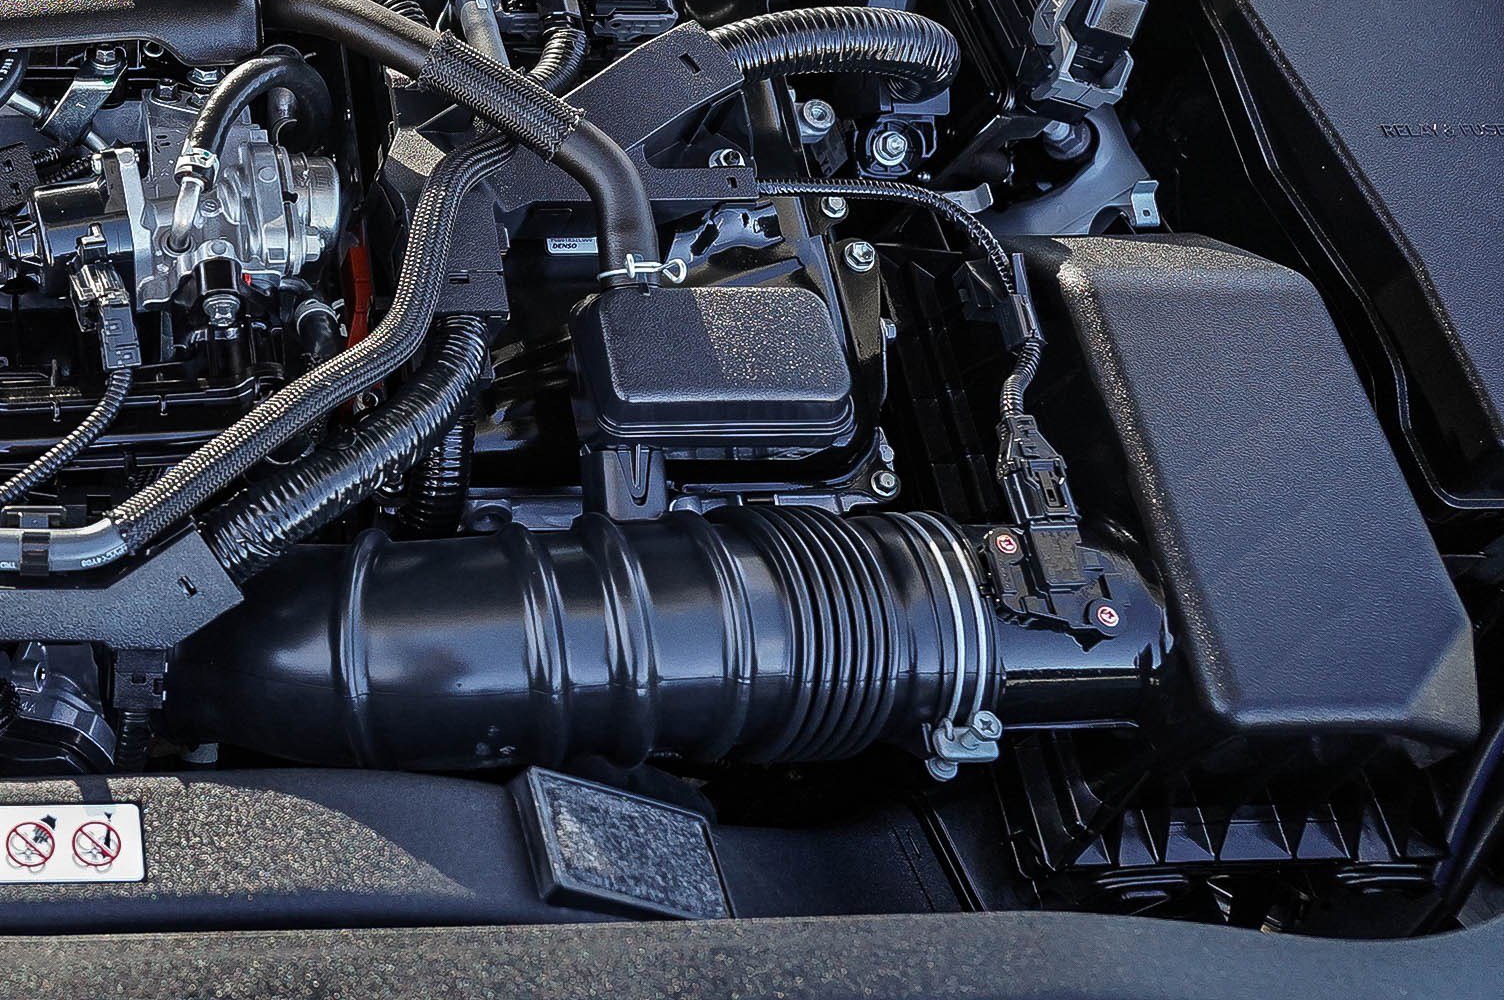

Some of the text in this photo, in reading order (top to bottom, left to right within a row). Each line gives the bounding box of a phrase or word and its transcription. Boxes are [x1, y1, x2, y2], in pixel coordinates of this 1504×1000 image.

[1376, 123, 1438, 138] RELAY
[1441, 123, 1455, 138] &
[552, 242, 578, 250] DENSO
